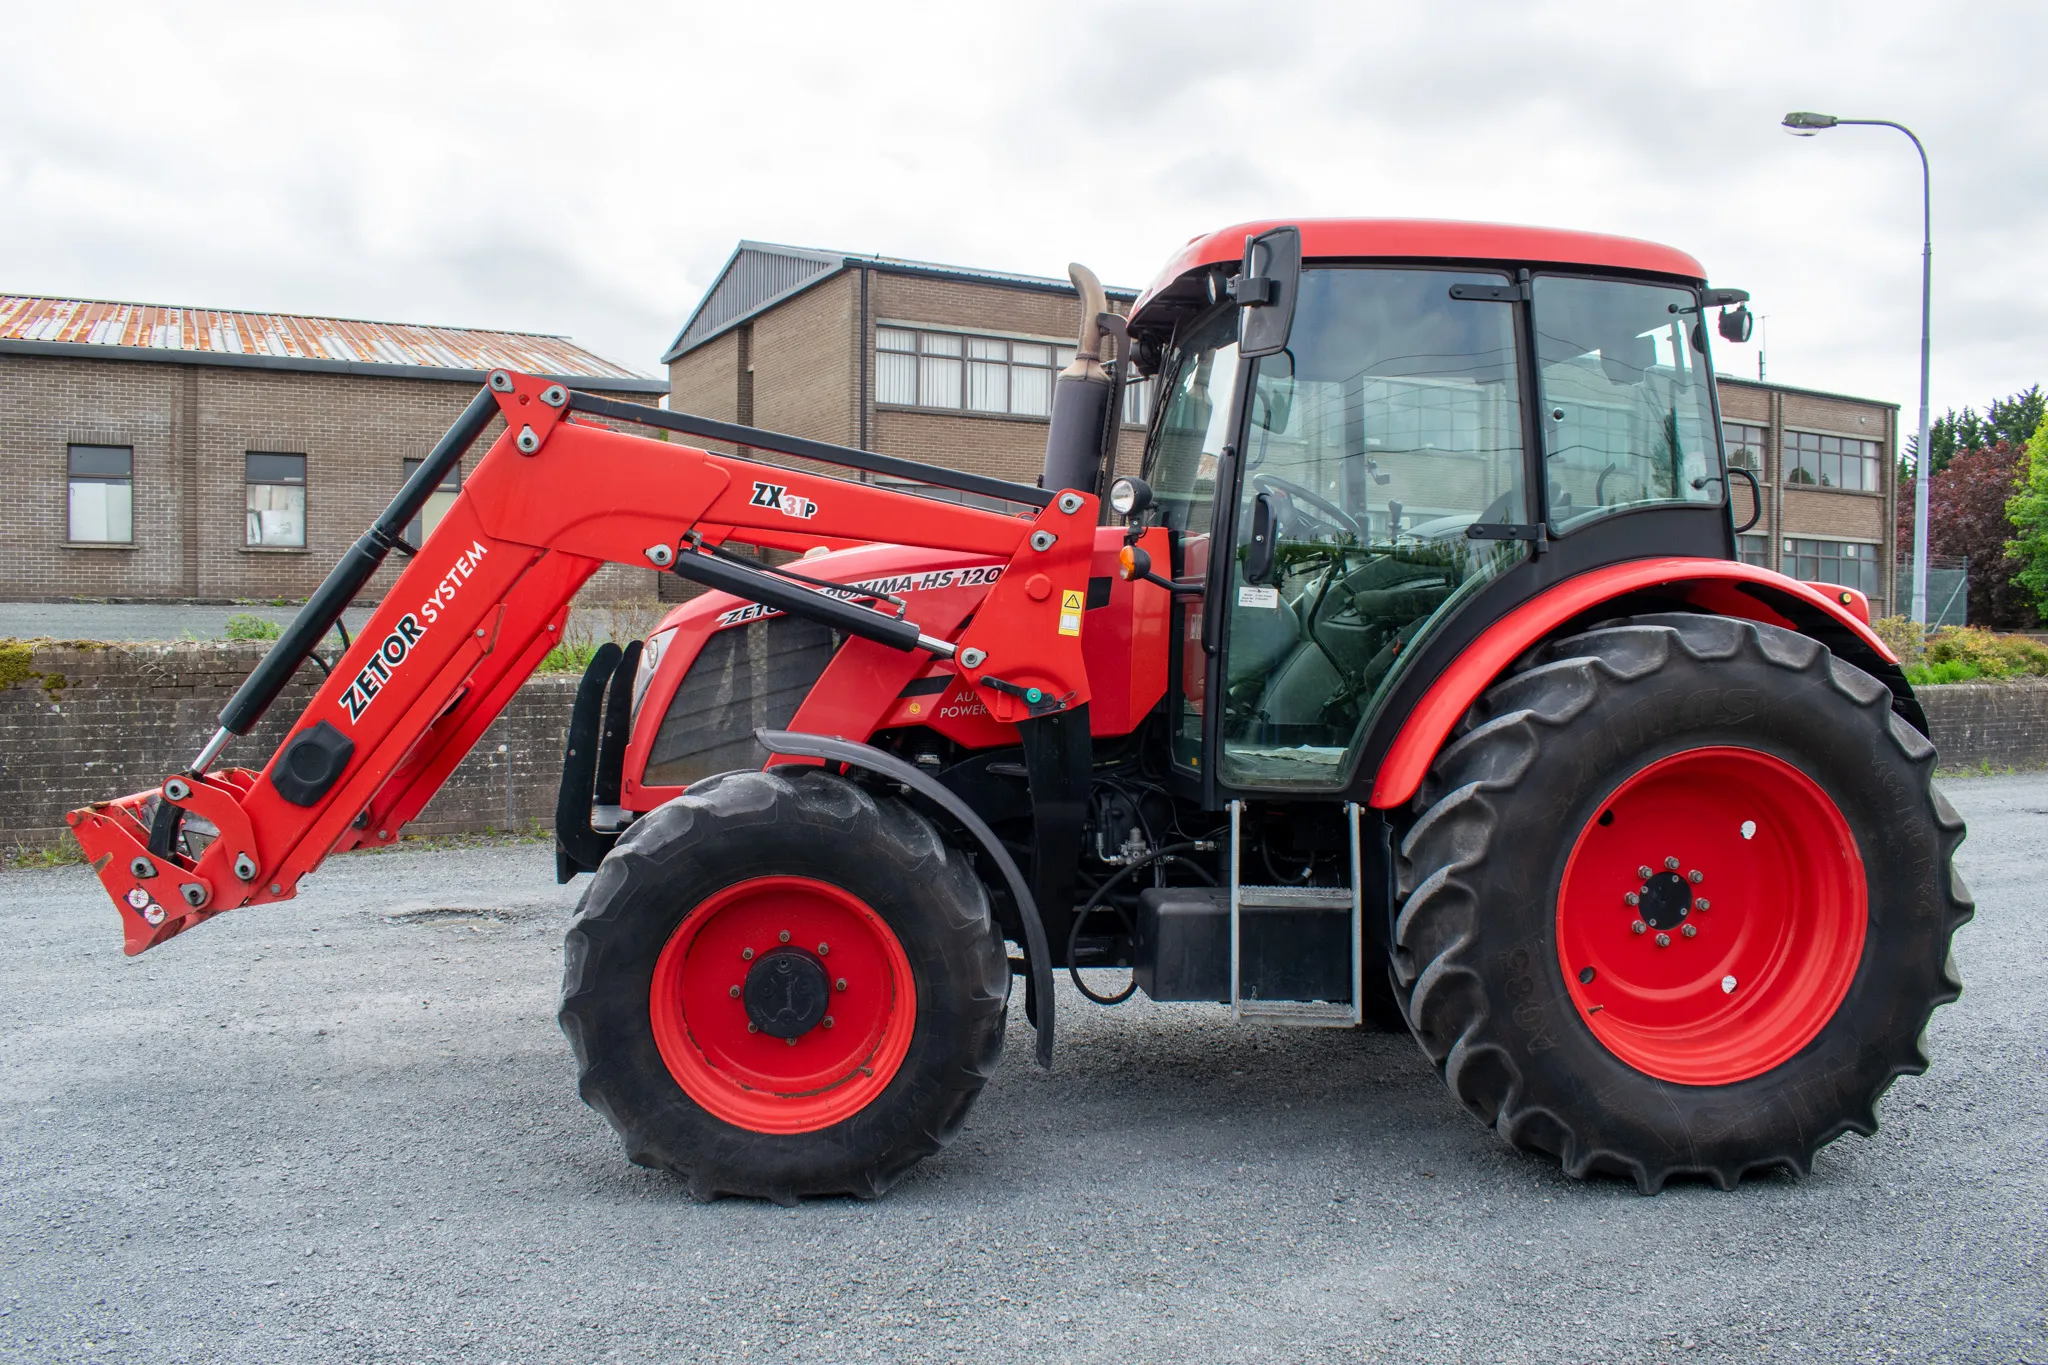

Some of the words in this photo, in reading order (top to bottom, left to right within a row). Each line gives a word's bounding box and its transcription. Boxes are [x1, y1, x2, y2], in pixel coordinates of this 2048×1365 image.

[920, 572, 953, 589] HS
[960, 567, 1003, 585] 120
[338, 613, 428, 725] ZETOR
[421, 540, 488, 623] SYSTEM
[940, 704, 990, 719] POWER
